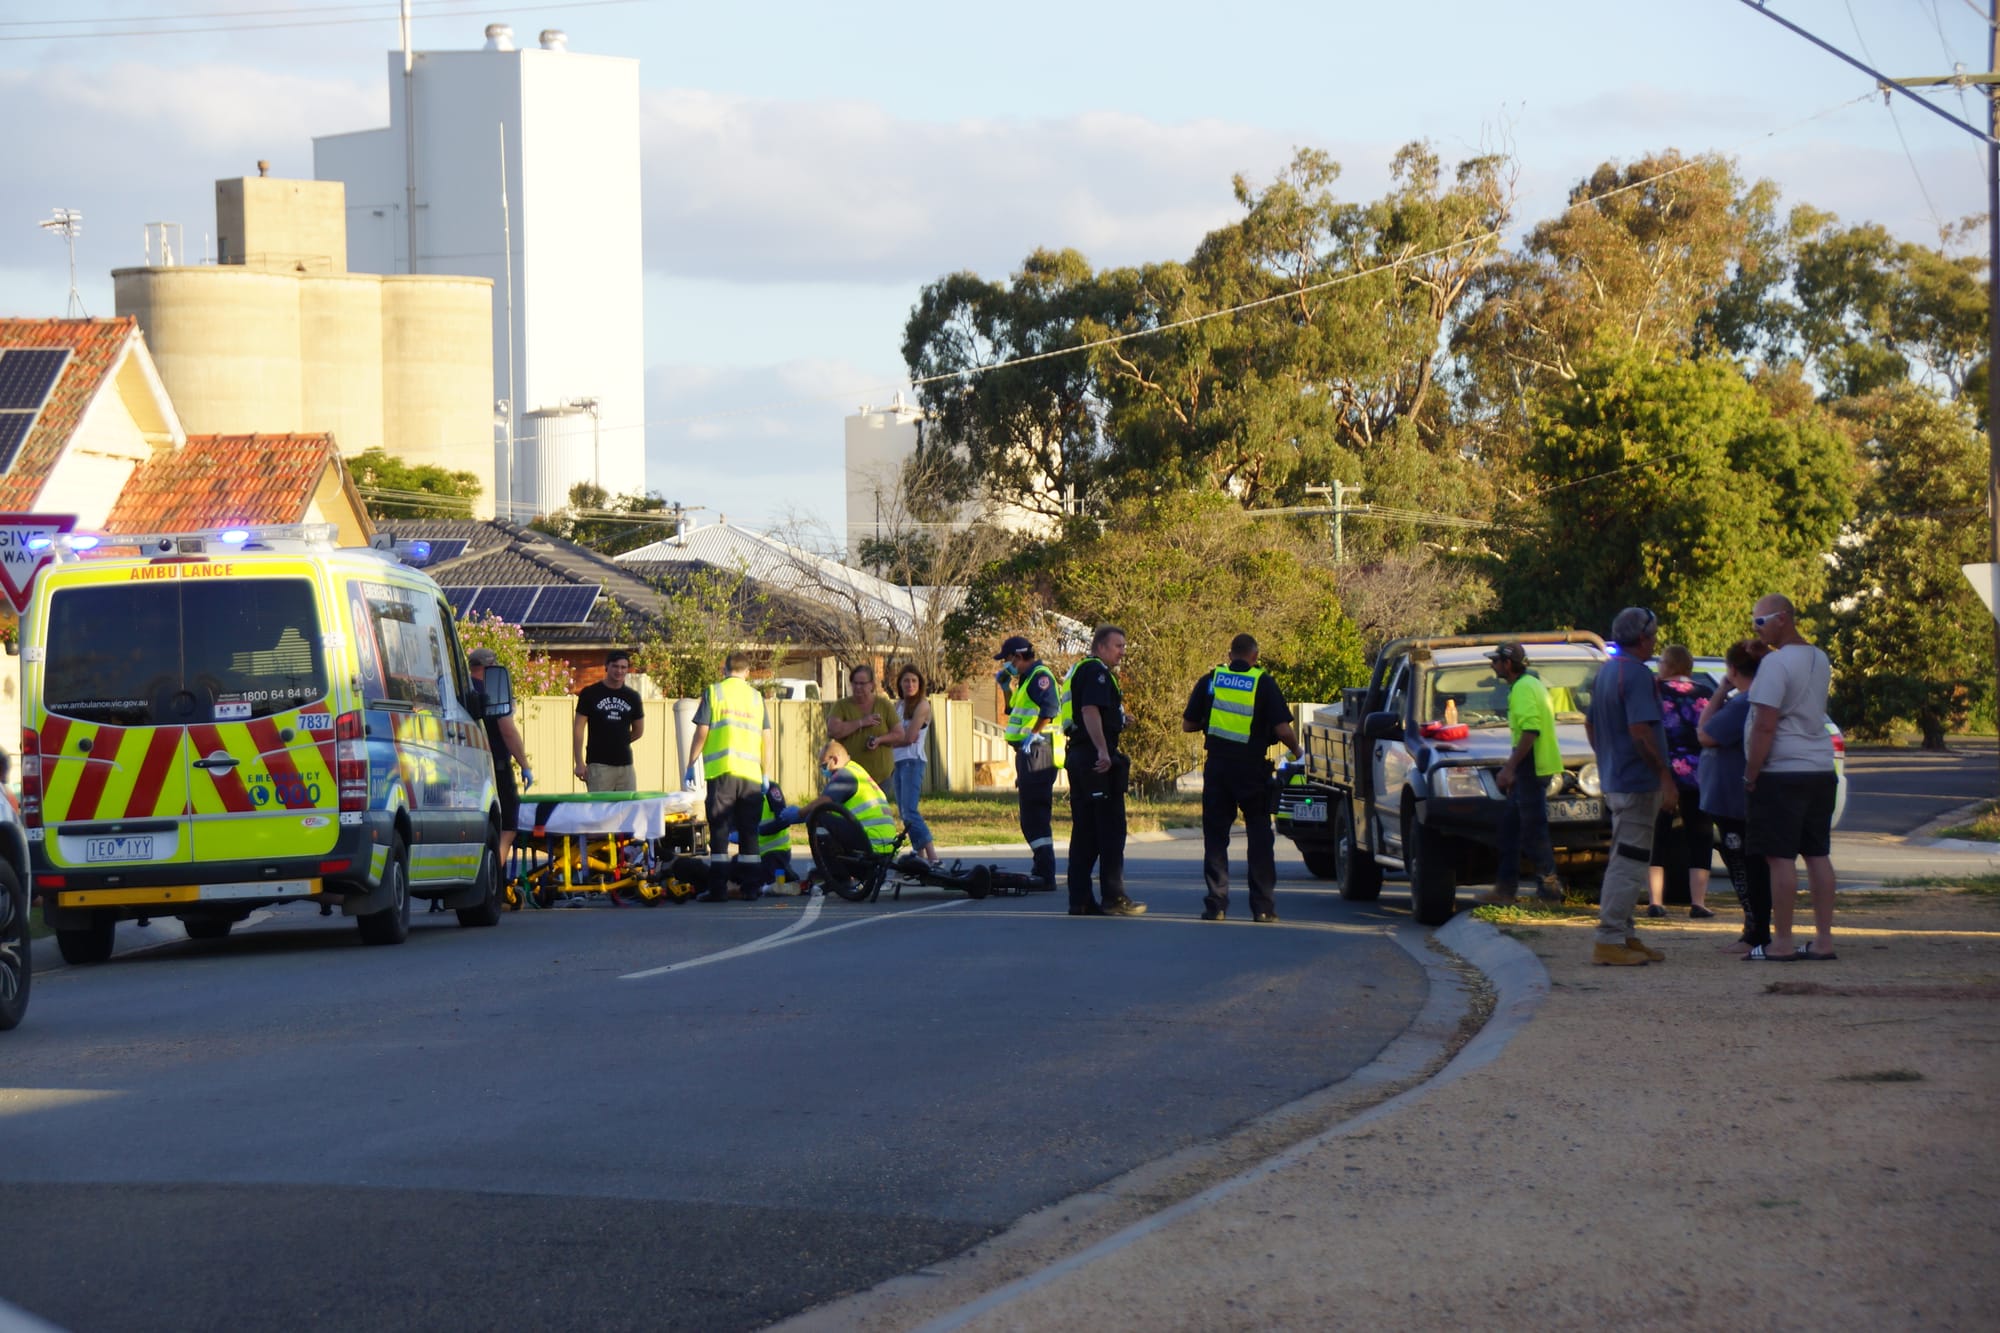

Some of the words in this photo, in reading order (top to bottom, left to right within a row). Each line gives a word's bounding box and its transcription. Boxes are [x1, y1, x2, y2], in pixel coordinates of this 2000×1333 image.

[4, 551, 35, 563] WAY
[130, 563, 233, 580] AMBULANCE
[1216, 674, 1253, 689] Police
[242, 691, 268, 702] 1800
[270, 690, 284, 700] 64
[287, 688, 301, 698] 84
[304, 687, 318, 697] 84
[50, 699, 149, 710] www.ambulance.vic.gov.au
[299, 714, 331, 729] 7837
[275, 783, 321, 805] 000
[1576, 801, 1599, 816] 338
